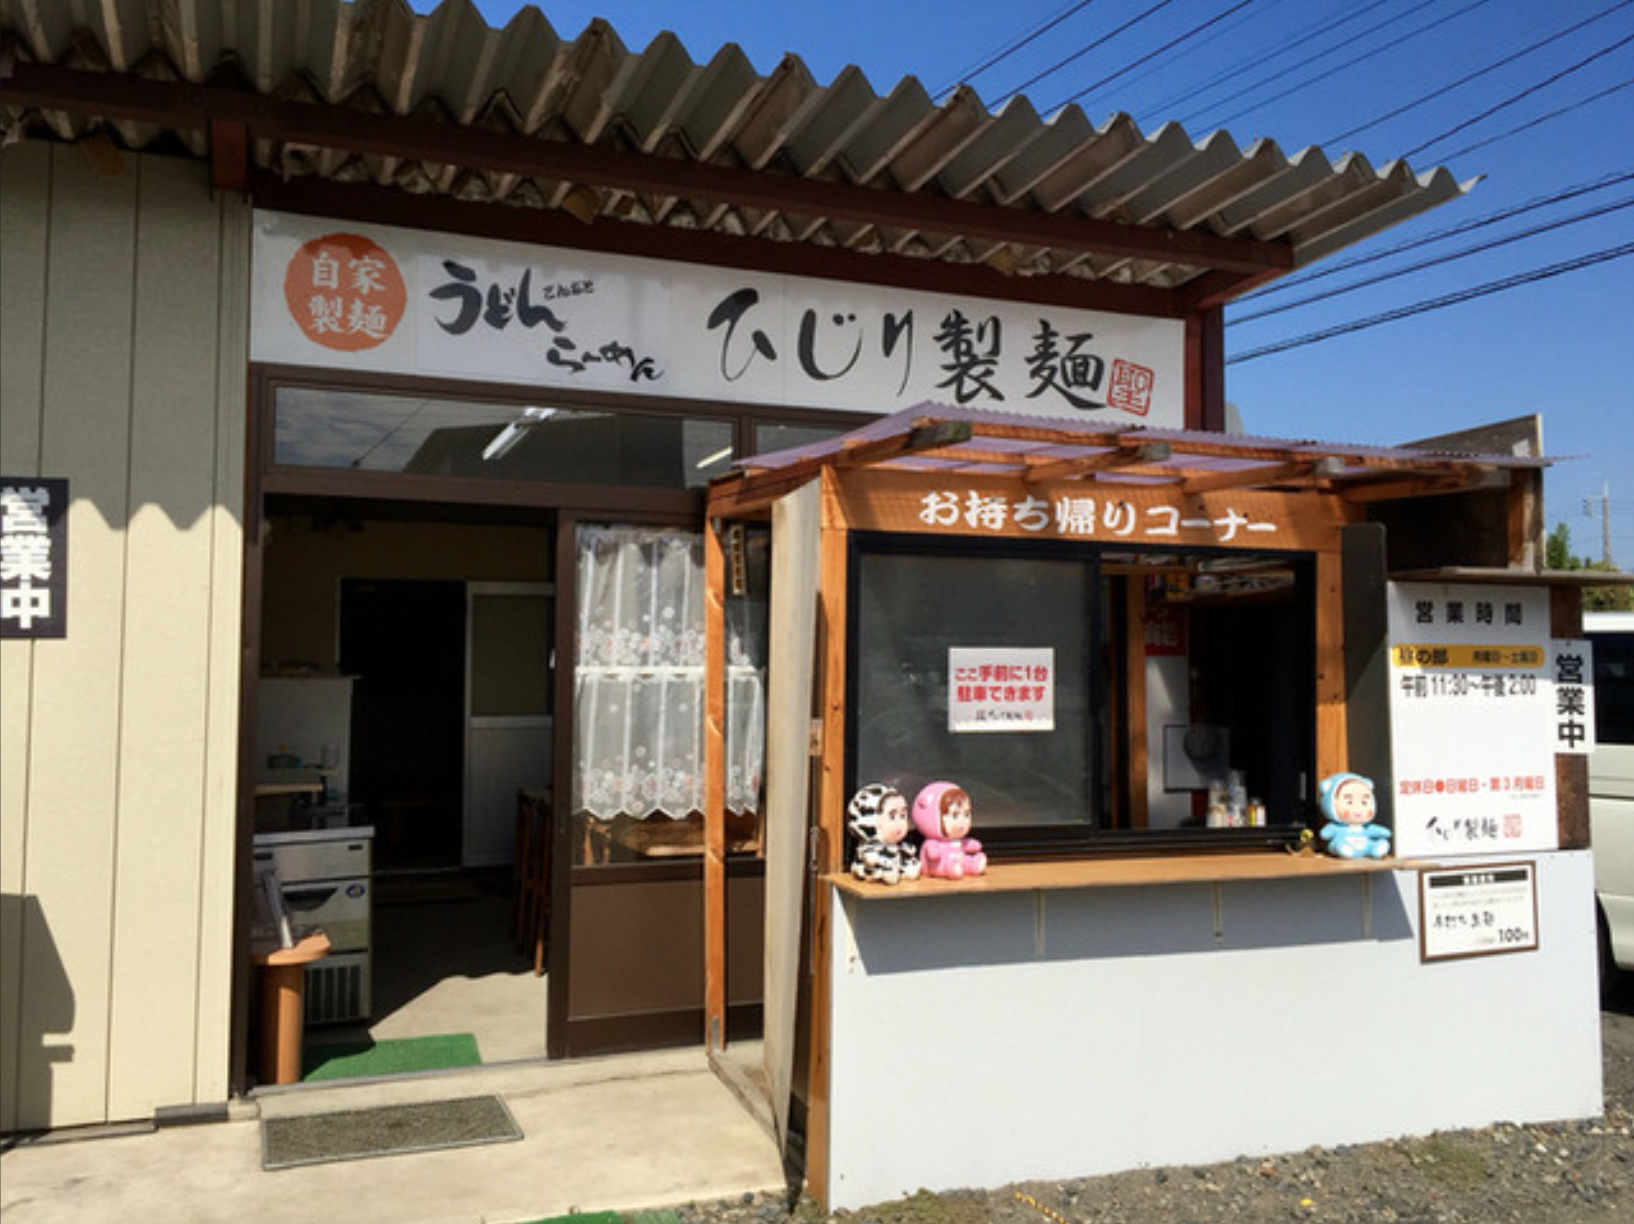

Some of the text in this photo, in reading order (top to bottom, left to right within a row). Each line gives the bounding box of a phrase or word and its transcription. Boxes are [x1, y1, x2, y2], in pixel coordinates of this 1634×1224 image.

[311, 252, 387, 294] 自家
[429, 260, 566, 335] うどん
[308, 296, 389, 341] 製麺
[546, 336, 665, 383] らーめん
[707, 287, 1107, 411] ひじり製麺
[919, 490, 1277, 542] お持ち帰りコーナー
[0, 486, 51, 629] 営業中
[1415, 601, 1523, 625] 営業時間
[957, 685, 1046, 702] 駐車できます
[1556, 653, 1585, 749] 営業中
